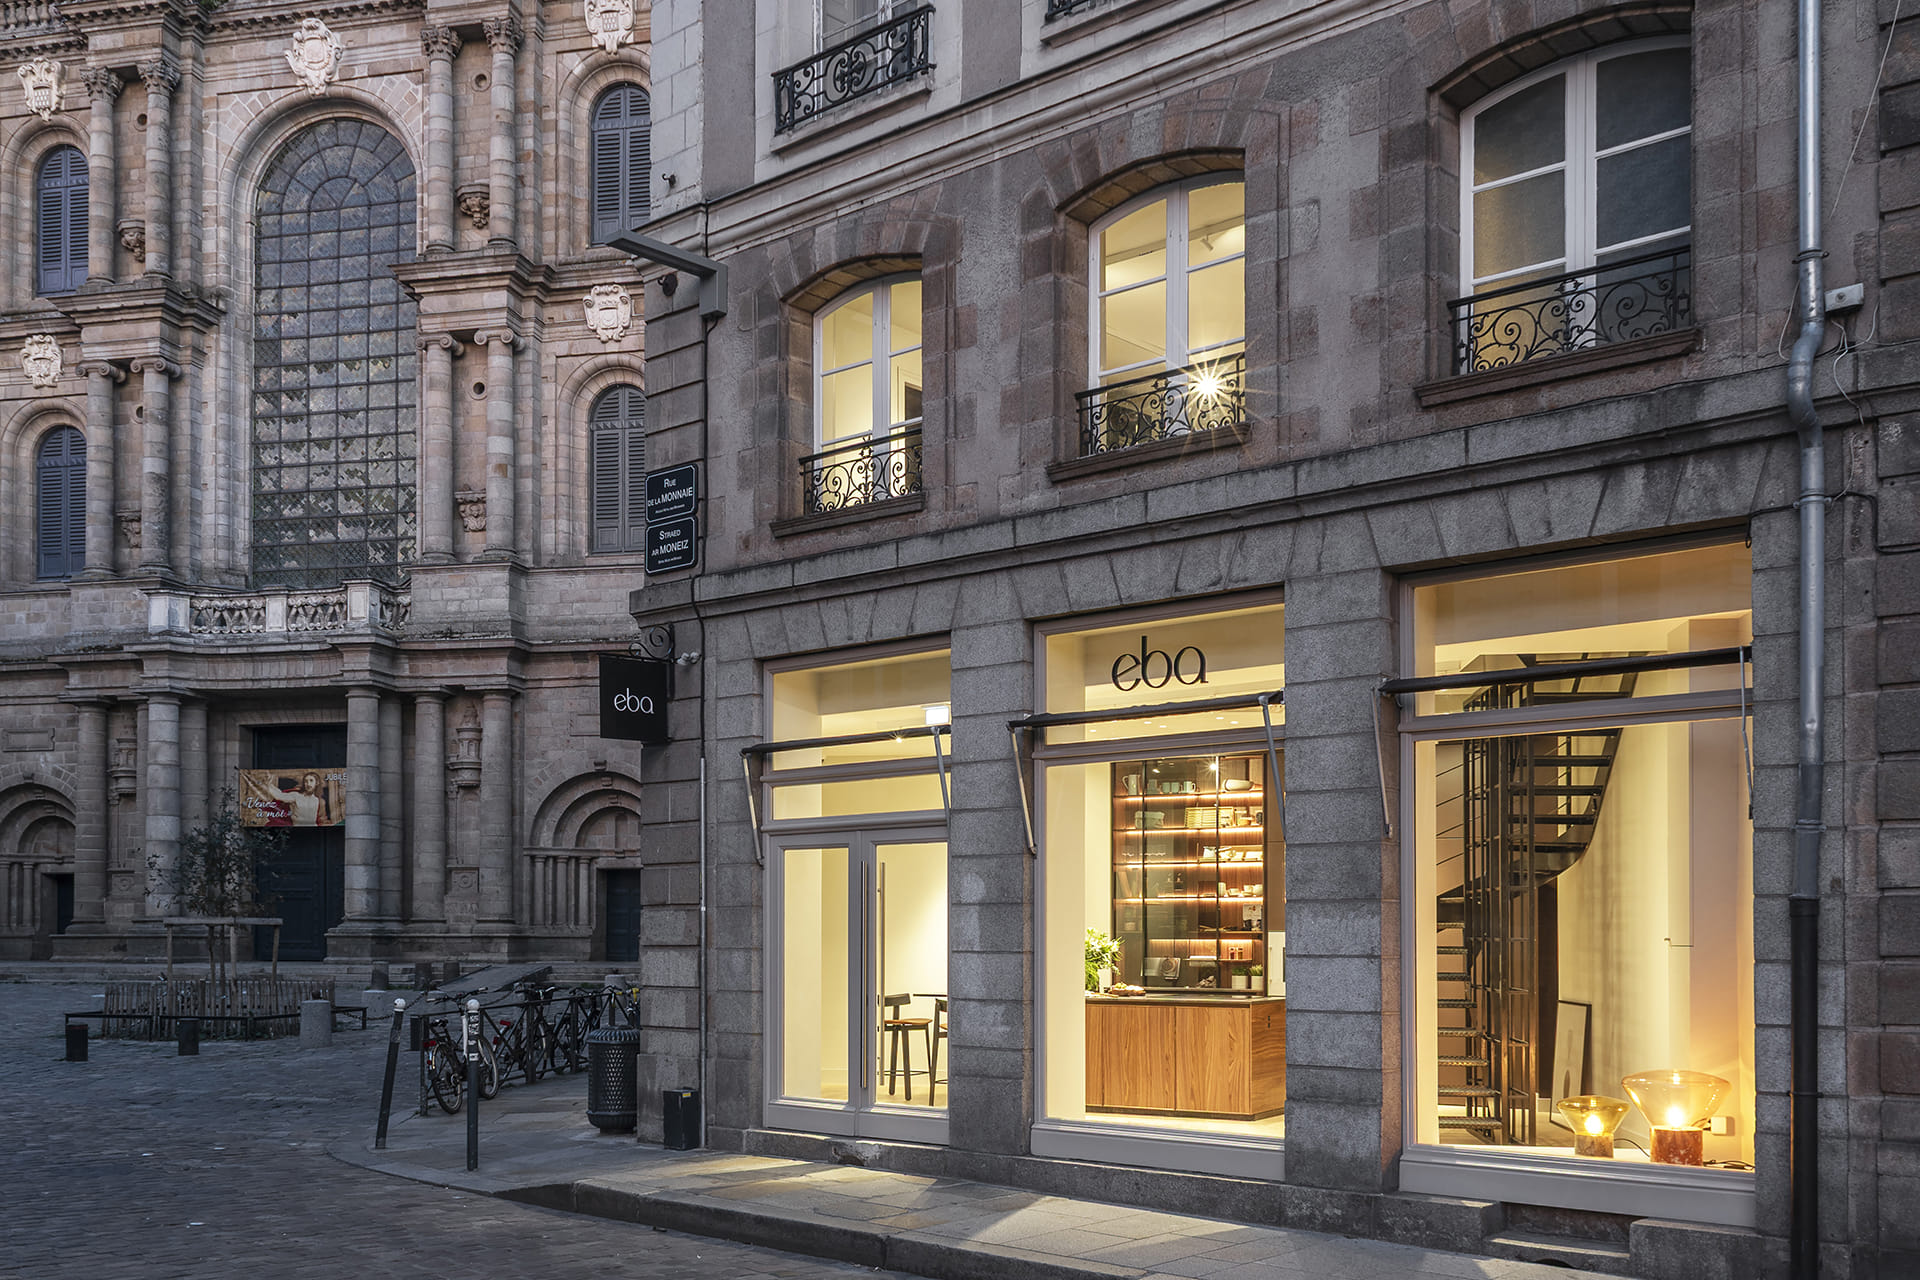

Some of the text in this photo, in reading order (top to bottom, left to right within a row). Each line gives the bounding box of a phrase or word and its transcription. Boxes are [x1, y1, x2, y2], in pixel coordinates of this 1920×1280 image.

[661, 486, 693, 503] MONNAIE
[651, 540, 689, 557] AR MONEIZ
[1111, 635, 1209, 692] eba
[614, 687, 655, 715] eba
[247, 797, 277, 808] Venez
